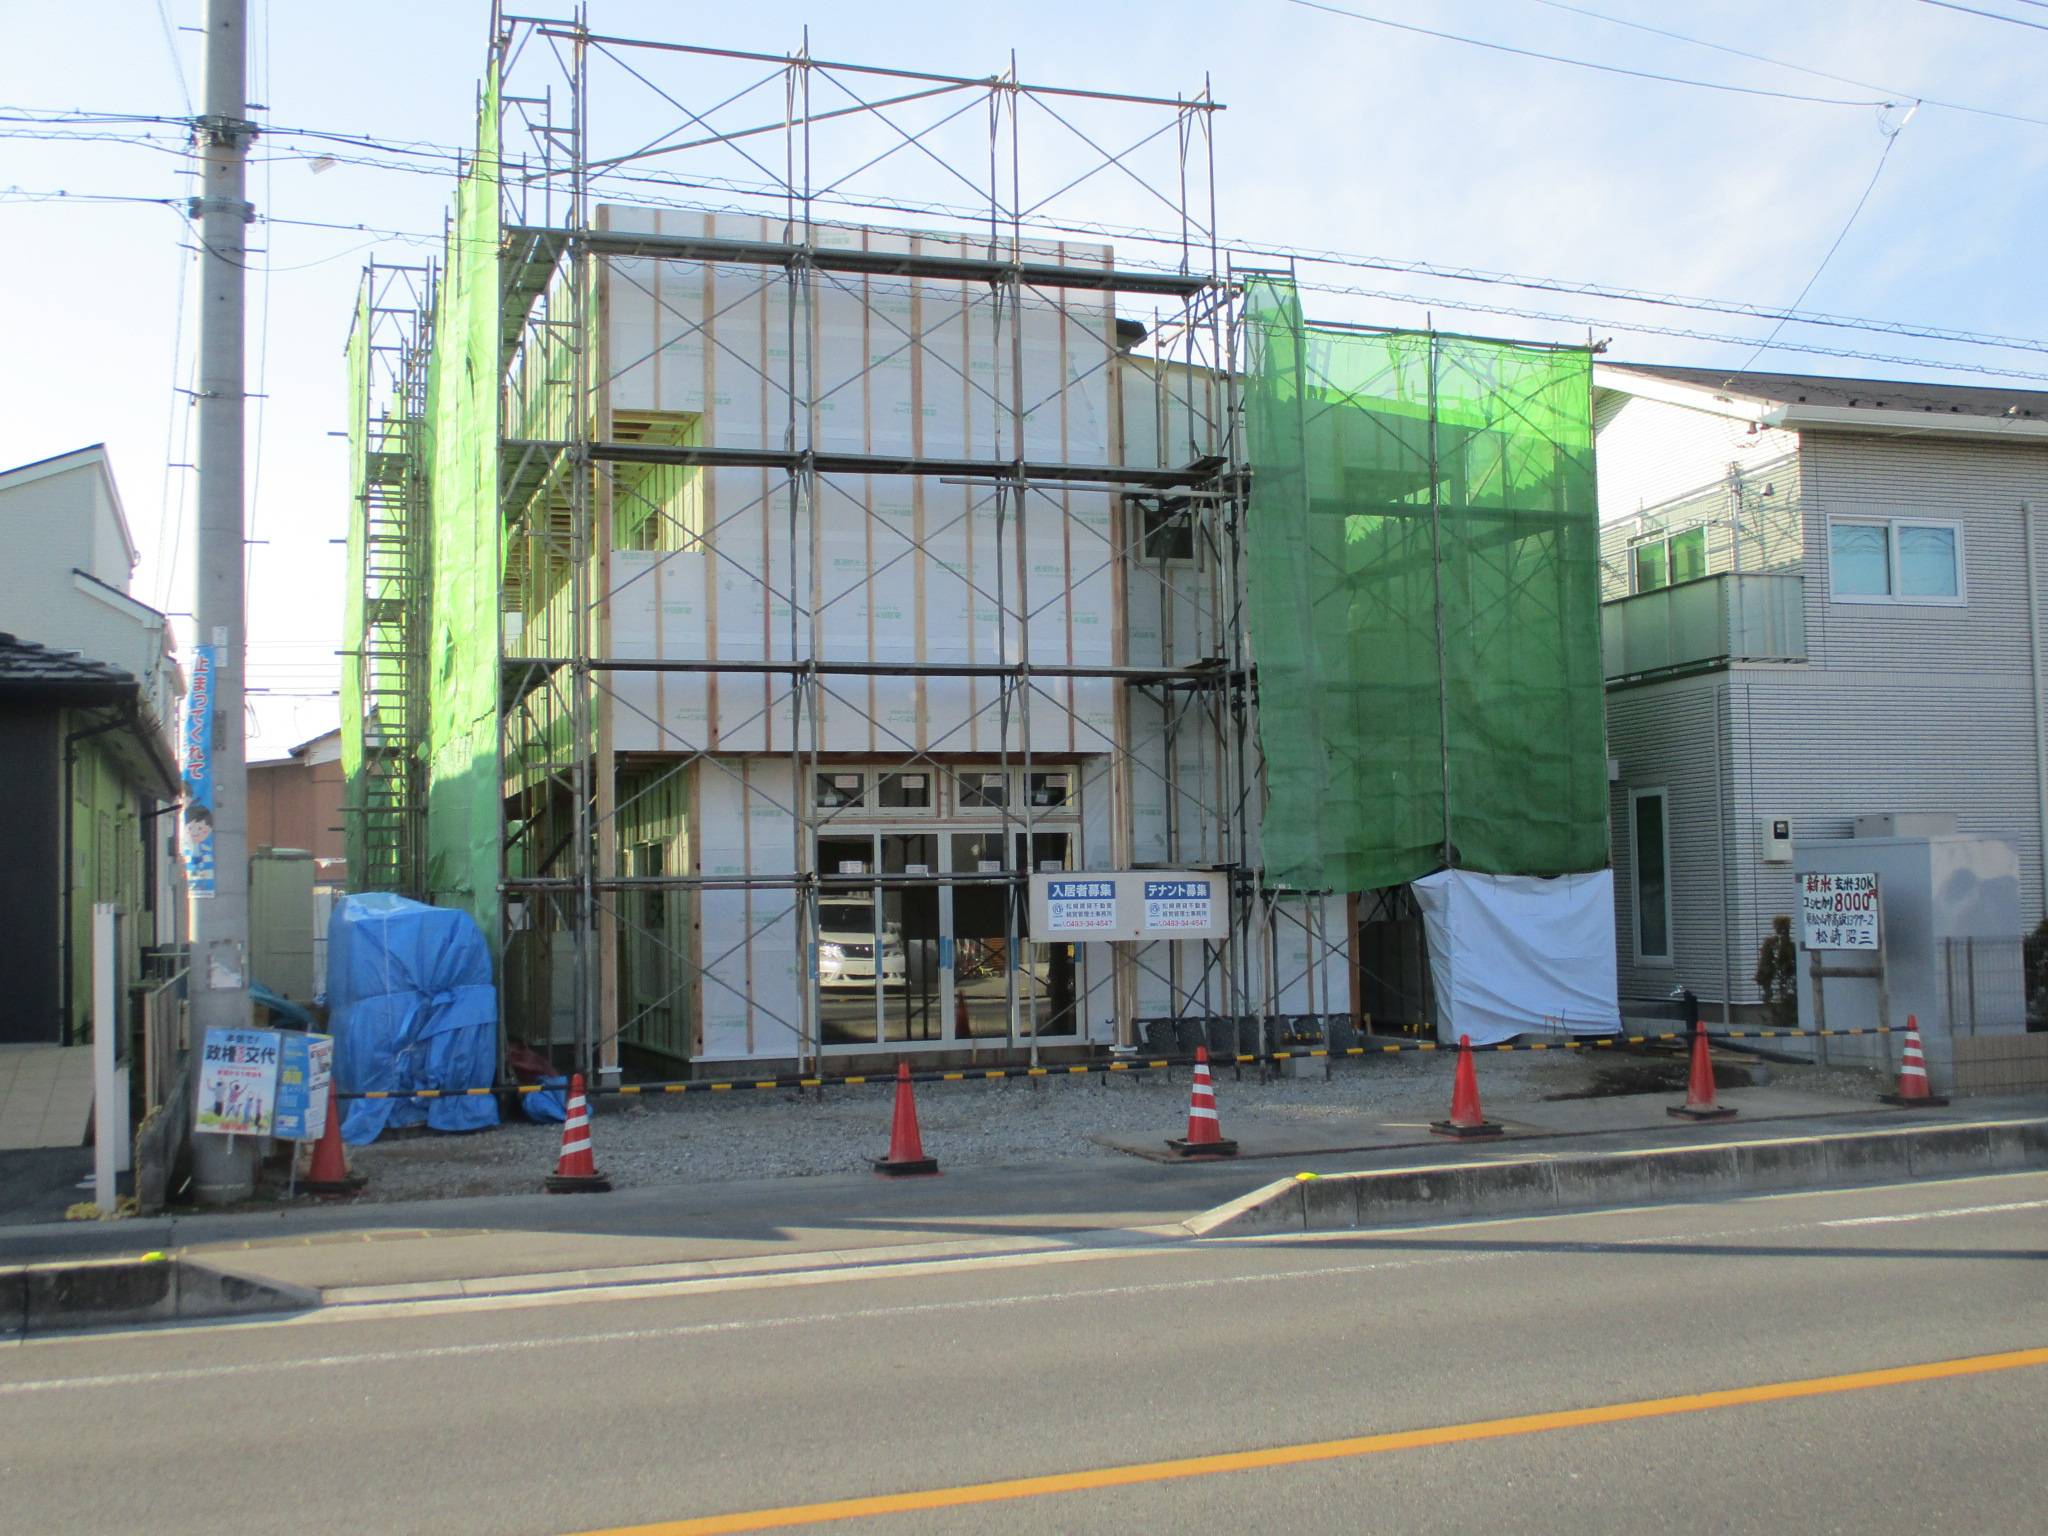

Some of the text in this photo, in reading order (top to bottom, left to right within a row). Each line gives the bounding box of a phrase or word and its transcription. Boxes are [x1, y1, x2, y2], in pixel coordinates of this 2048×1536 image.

[1052, 883, 1112, 897] 入居者募集
[1148, 883, 1207, 897] テナント募集
[1806, 873, 1832, 893] 新米
